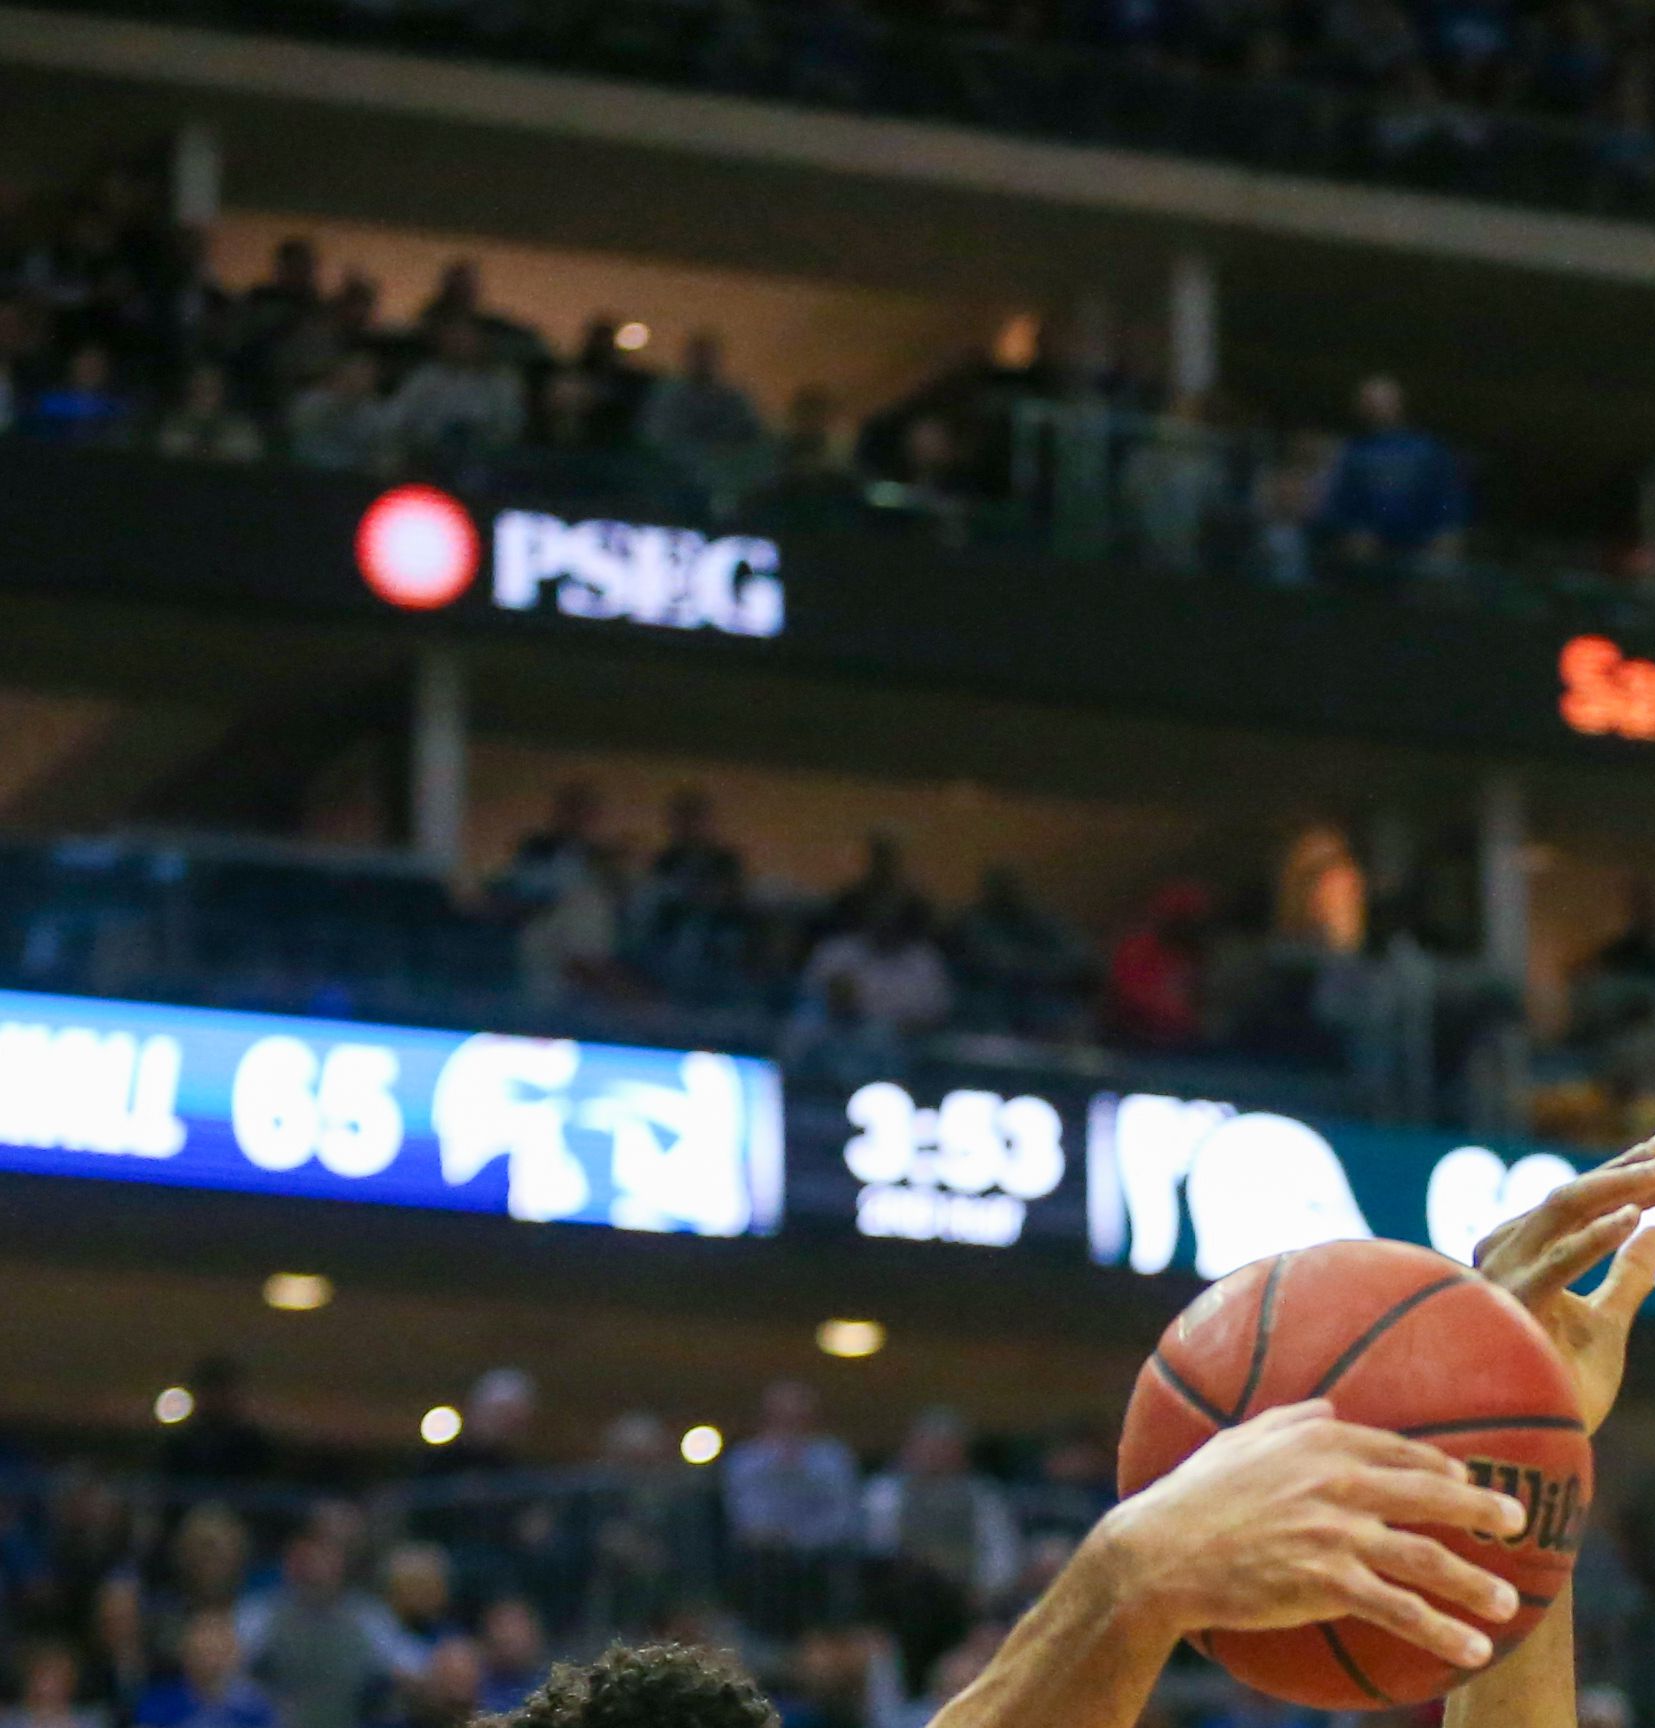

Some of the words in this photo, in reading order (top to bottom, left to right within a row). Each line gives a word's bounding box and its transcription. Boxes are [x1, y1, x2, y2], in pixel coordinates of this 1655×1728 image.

[494, 511, 784, 637] PSEG
[231, 1034, 403, 1177] 65
[843, 1081, 1066, 1200] 3:53
